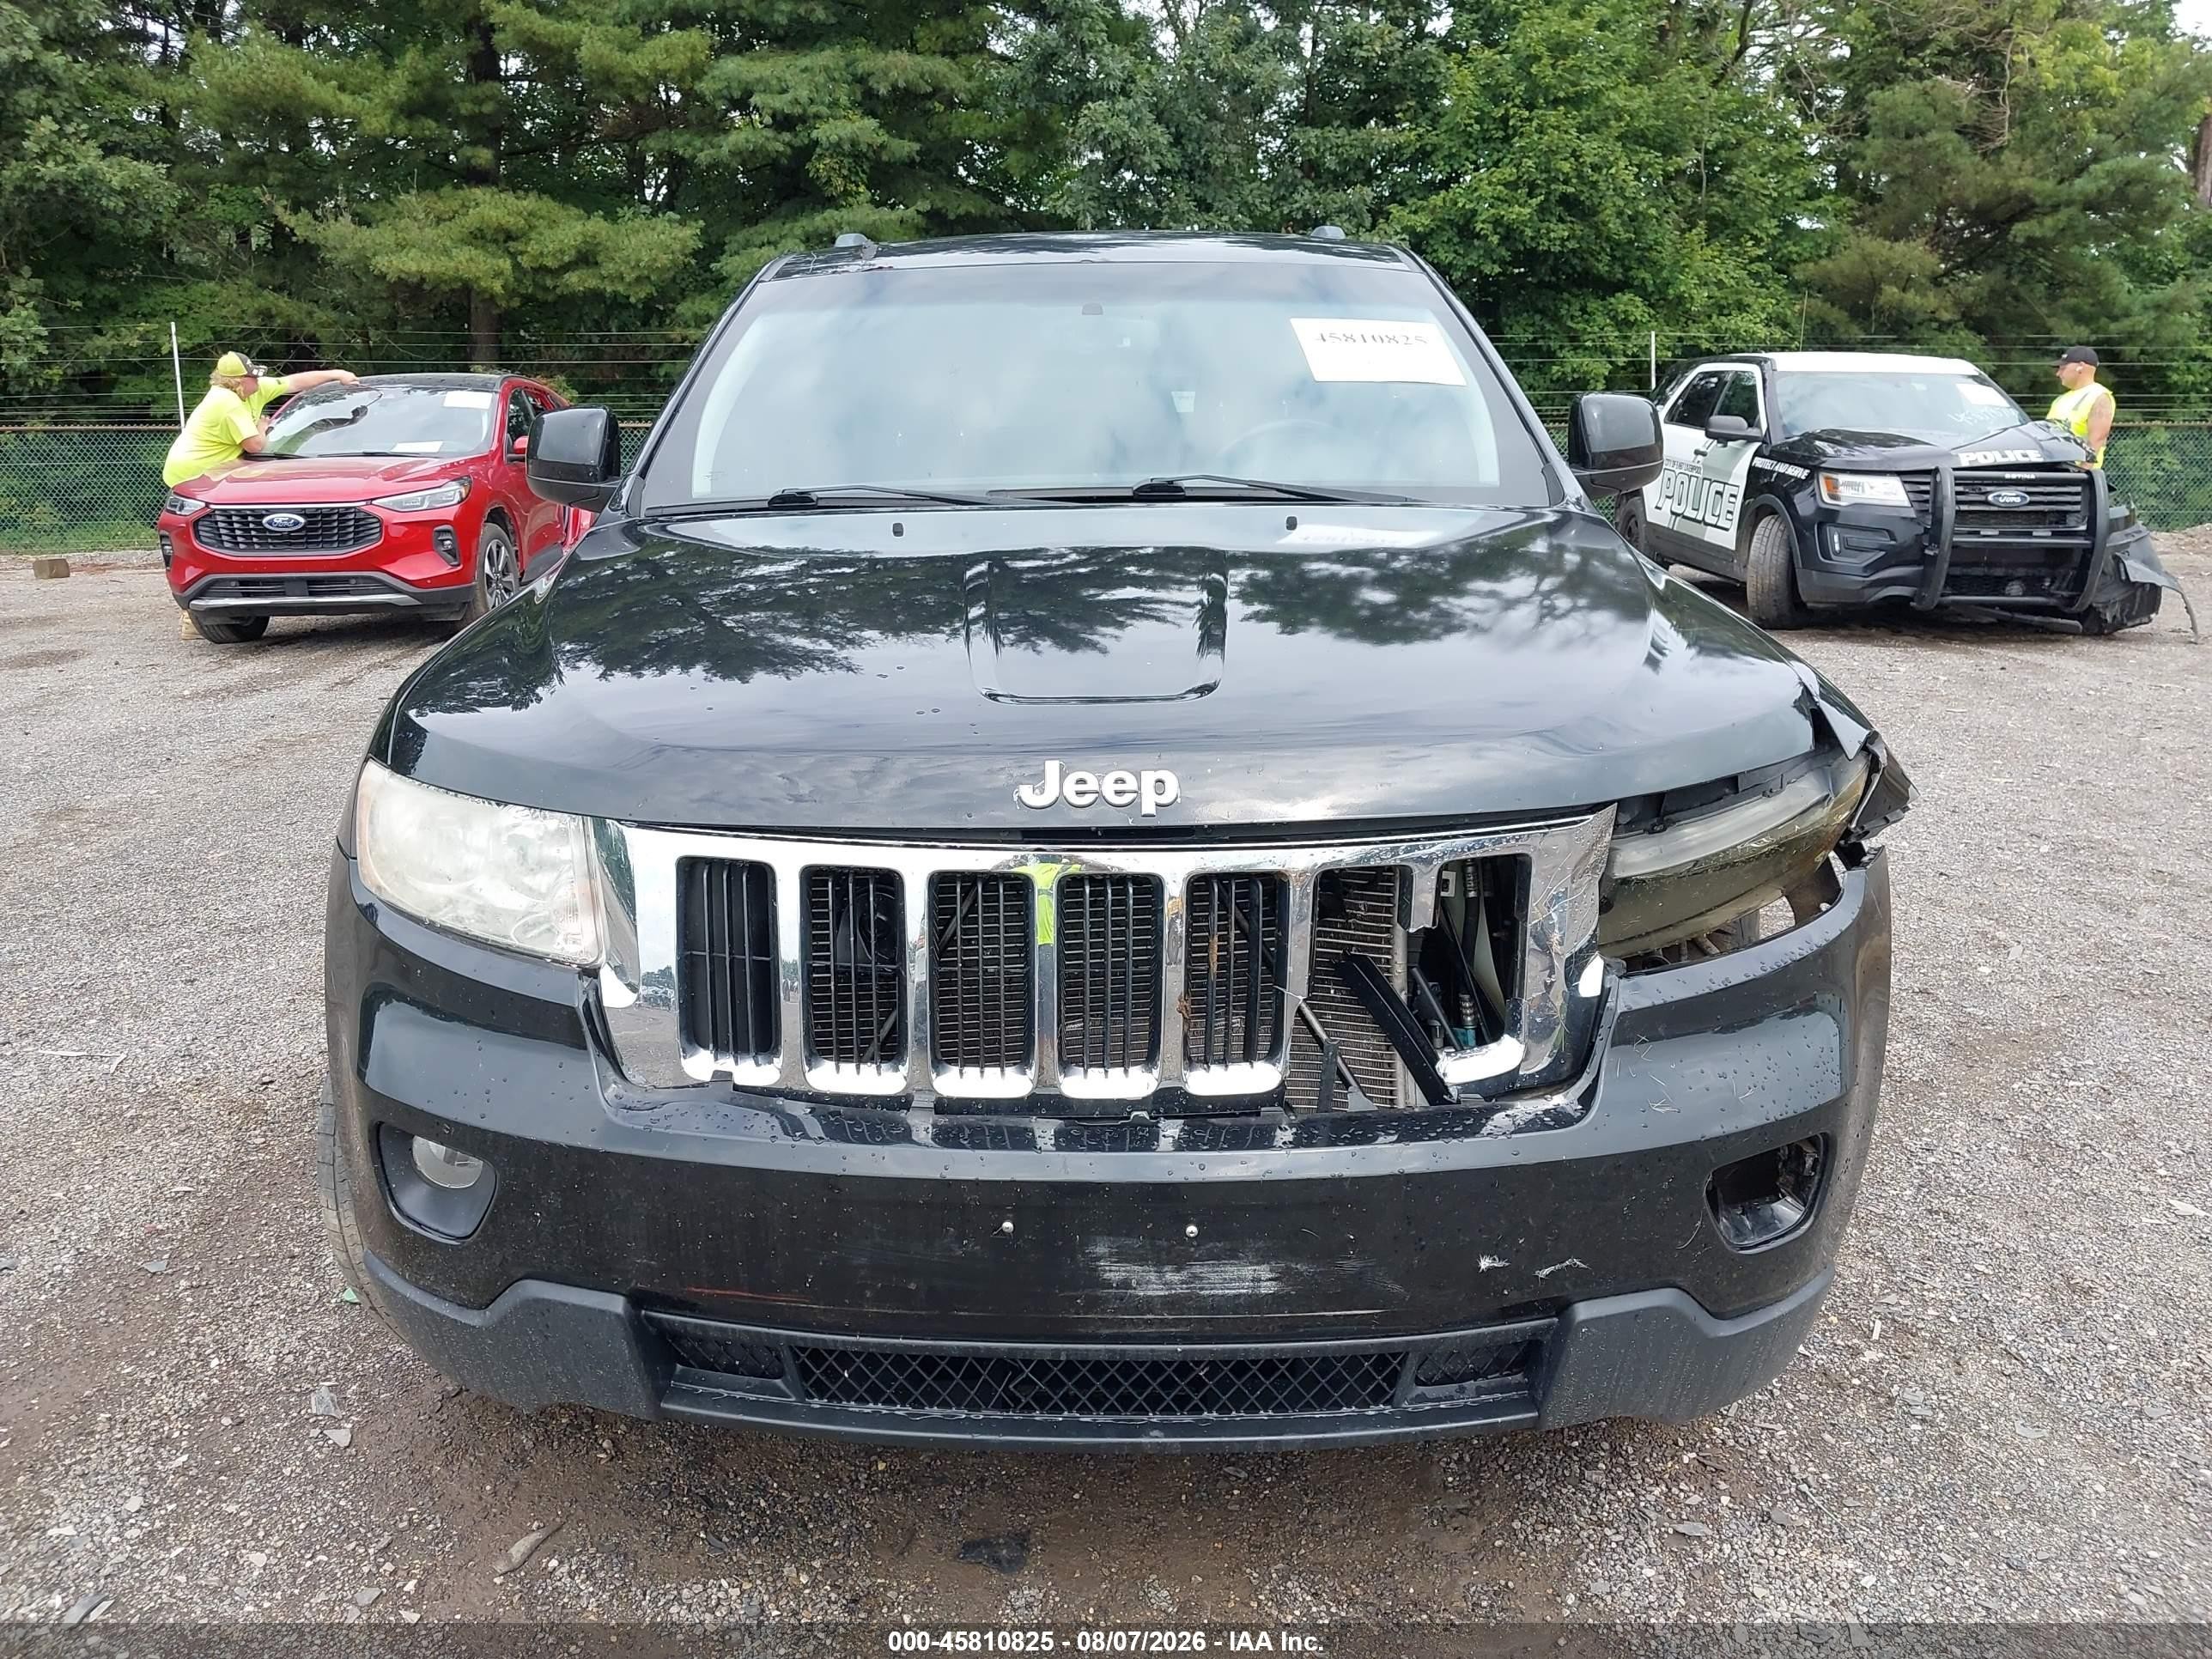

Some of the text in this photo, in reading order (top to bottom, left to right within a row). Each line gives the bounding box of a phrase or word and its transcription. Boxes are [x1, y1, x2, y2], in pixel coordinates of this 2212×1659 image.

[1785, 465, 1811, 480] SERVE
[1958, 449, 2045, 466] POLICE
[1654, 468, 1740, 532] POLICE
[1018, 760, 1179, 817] Jeep
